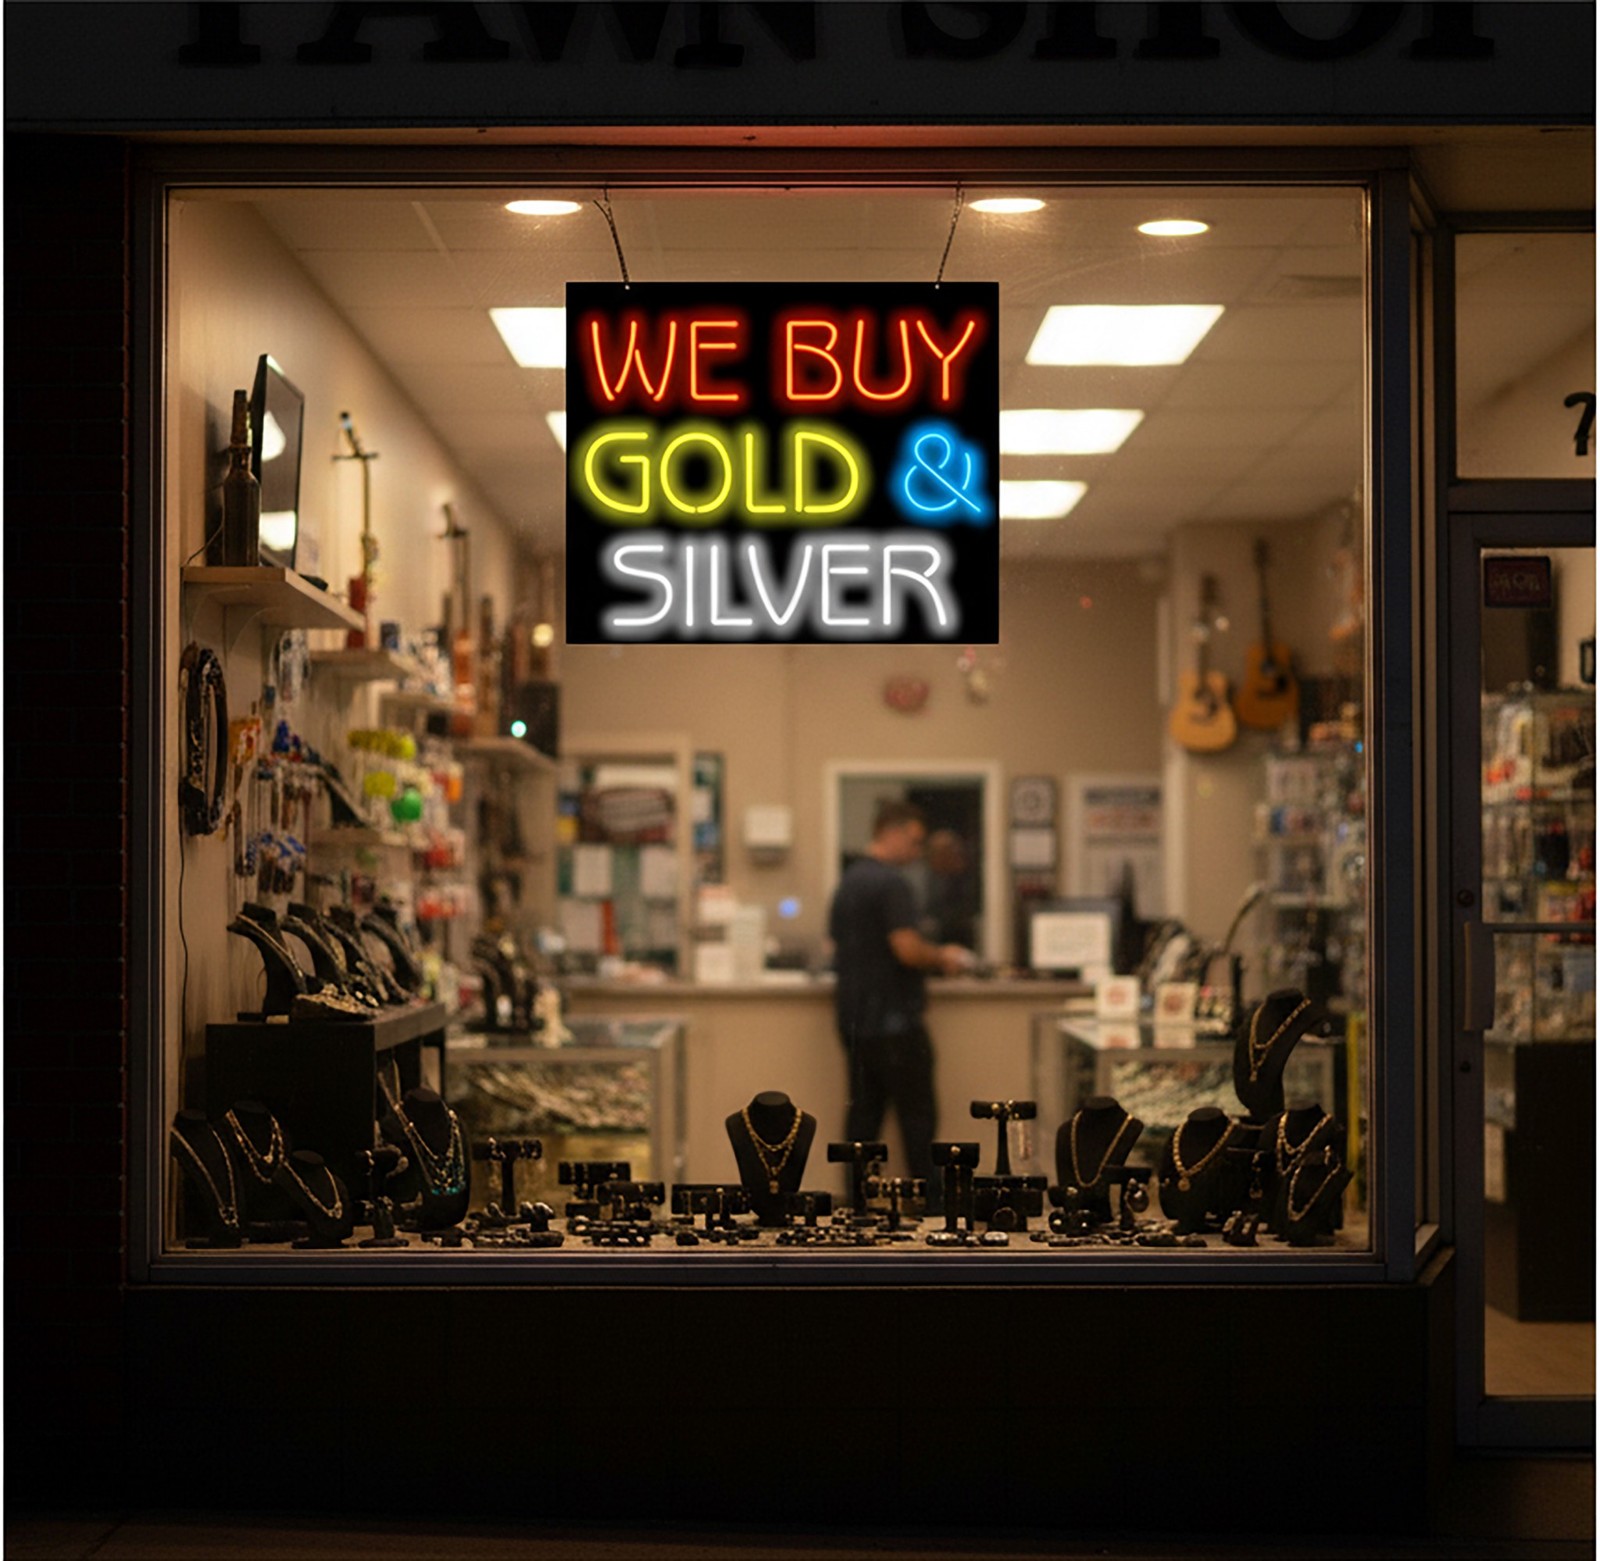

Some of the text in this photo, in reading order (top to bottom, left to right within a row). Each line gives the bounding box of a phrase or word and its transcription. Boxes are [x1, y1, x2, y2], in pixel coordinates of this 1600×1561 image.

[591, 319, 976, 402] WE BUY
[584, 430, 983, 515] GOLD &
[612, 543, 949, 628] SILVER
